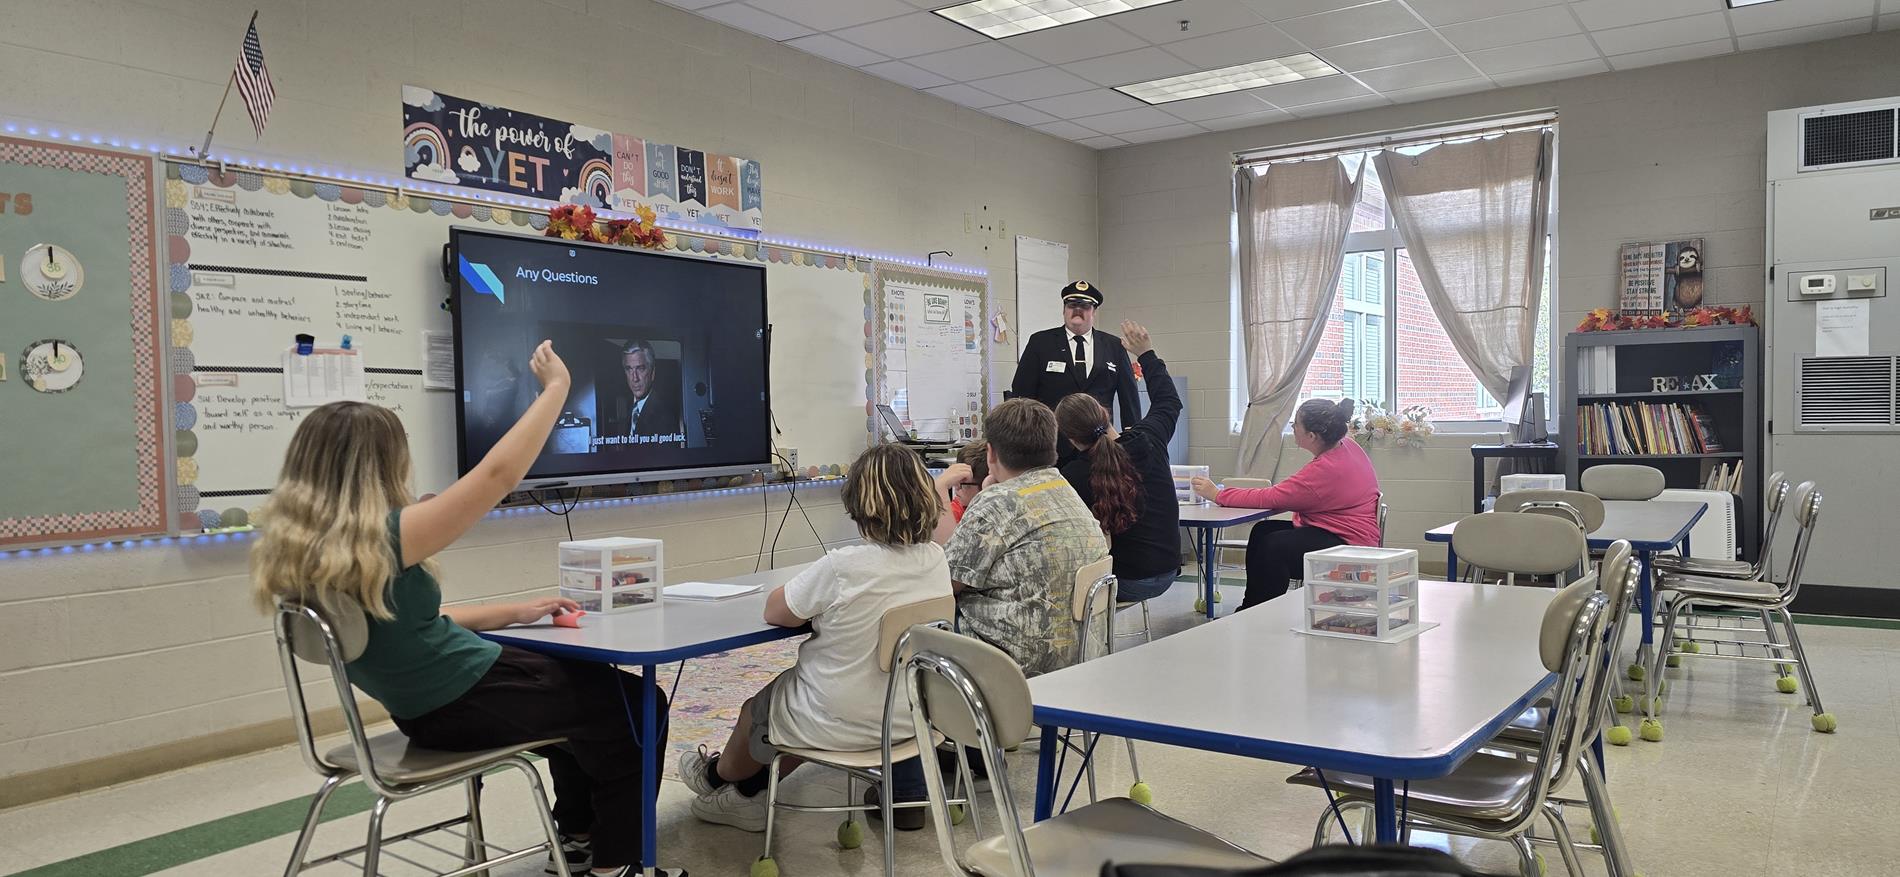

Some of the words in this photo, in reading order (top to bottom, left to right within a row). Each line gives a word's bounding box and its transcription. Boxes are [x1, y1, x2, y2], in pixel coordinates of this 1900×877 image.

[449, 107, 490, 138] the
[496, 125, 551, 152] power
[555, 132, 575, 159] of
[616, 151, 639, 161] CAN'T
[482, 146, 550, 192] YET
[623, 161, 634, 171] DO
[680, 163, 701, 175] DON'T
[652, 170, 670, 180] GOOD
[711, 186, 735, 196] WORK
[210, 203, 241, 217] Effectively
[621, 199, 636, 209] YET
[655, 203, 669, 214] YET
[687, 208, 699, 218] YET
[716, 213, 730, 223] YET
[191, 214, 206, 222] with
[257, 221, 272, 230] with
[516, 266, 540, 282] Any
[541, 268, 599, 285] Questions
[1634, 279, 1655, 287] POSITVE
[218, 291, 247, 303] Compare
[197, 303, 225, 316] healthy
[248, 310, 278, 320] unhealthy
[281, 311, 312, 323] behaviors
[1651, 374, 1719, 393] REAX
[216, 394, 247, 405] Develop
[251, 394, 281, 405] positive
[204, 407, 228, 418] toward
[233, 409, 248, 417] self
[277, 410, 300, 421] unique
[203, 421, 217, 430] and
[219, 420, 244, 433] worthy
[592, 434, 604, 447] just
[605, 434, 620, 444] want
[621, 434, 628, 444] to
[629, 433, 639, 444] tell
[639, 436, 650, 445] you
[650, 433, 658, 443] all
[659, 433, 673, 444] good
